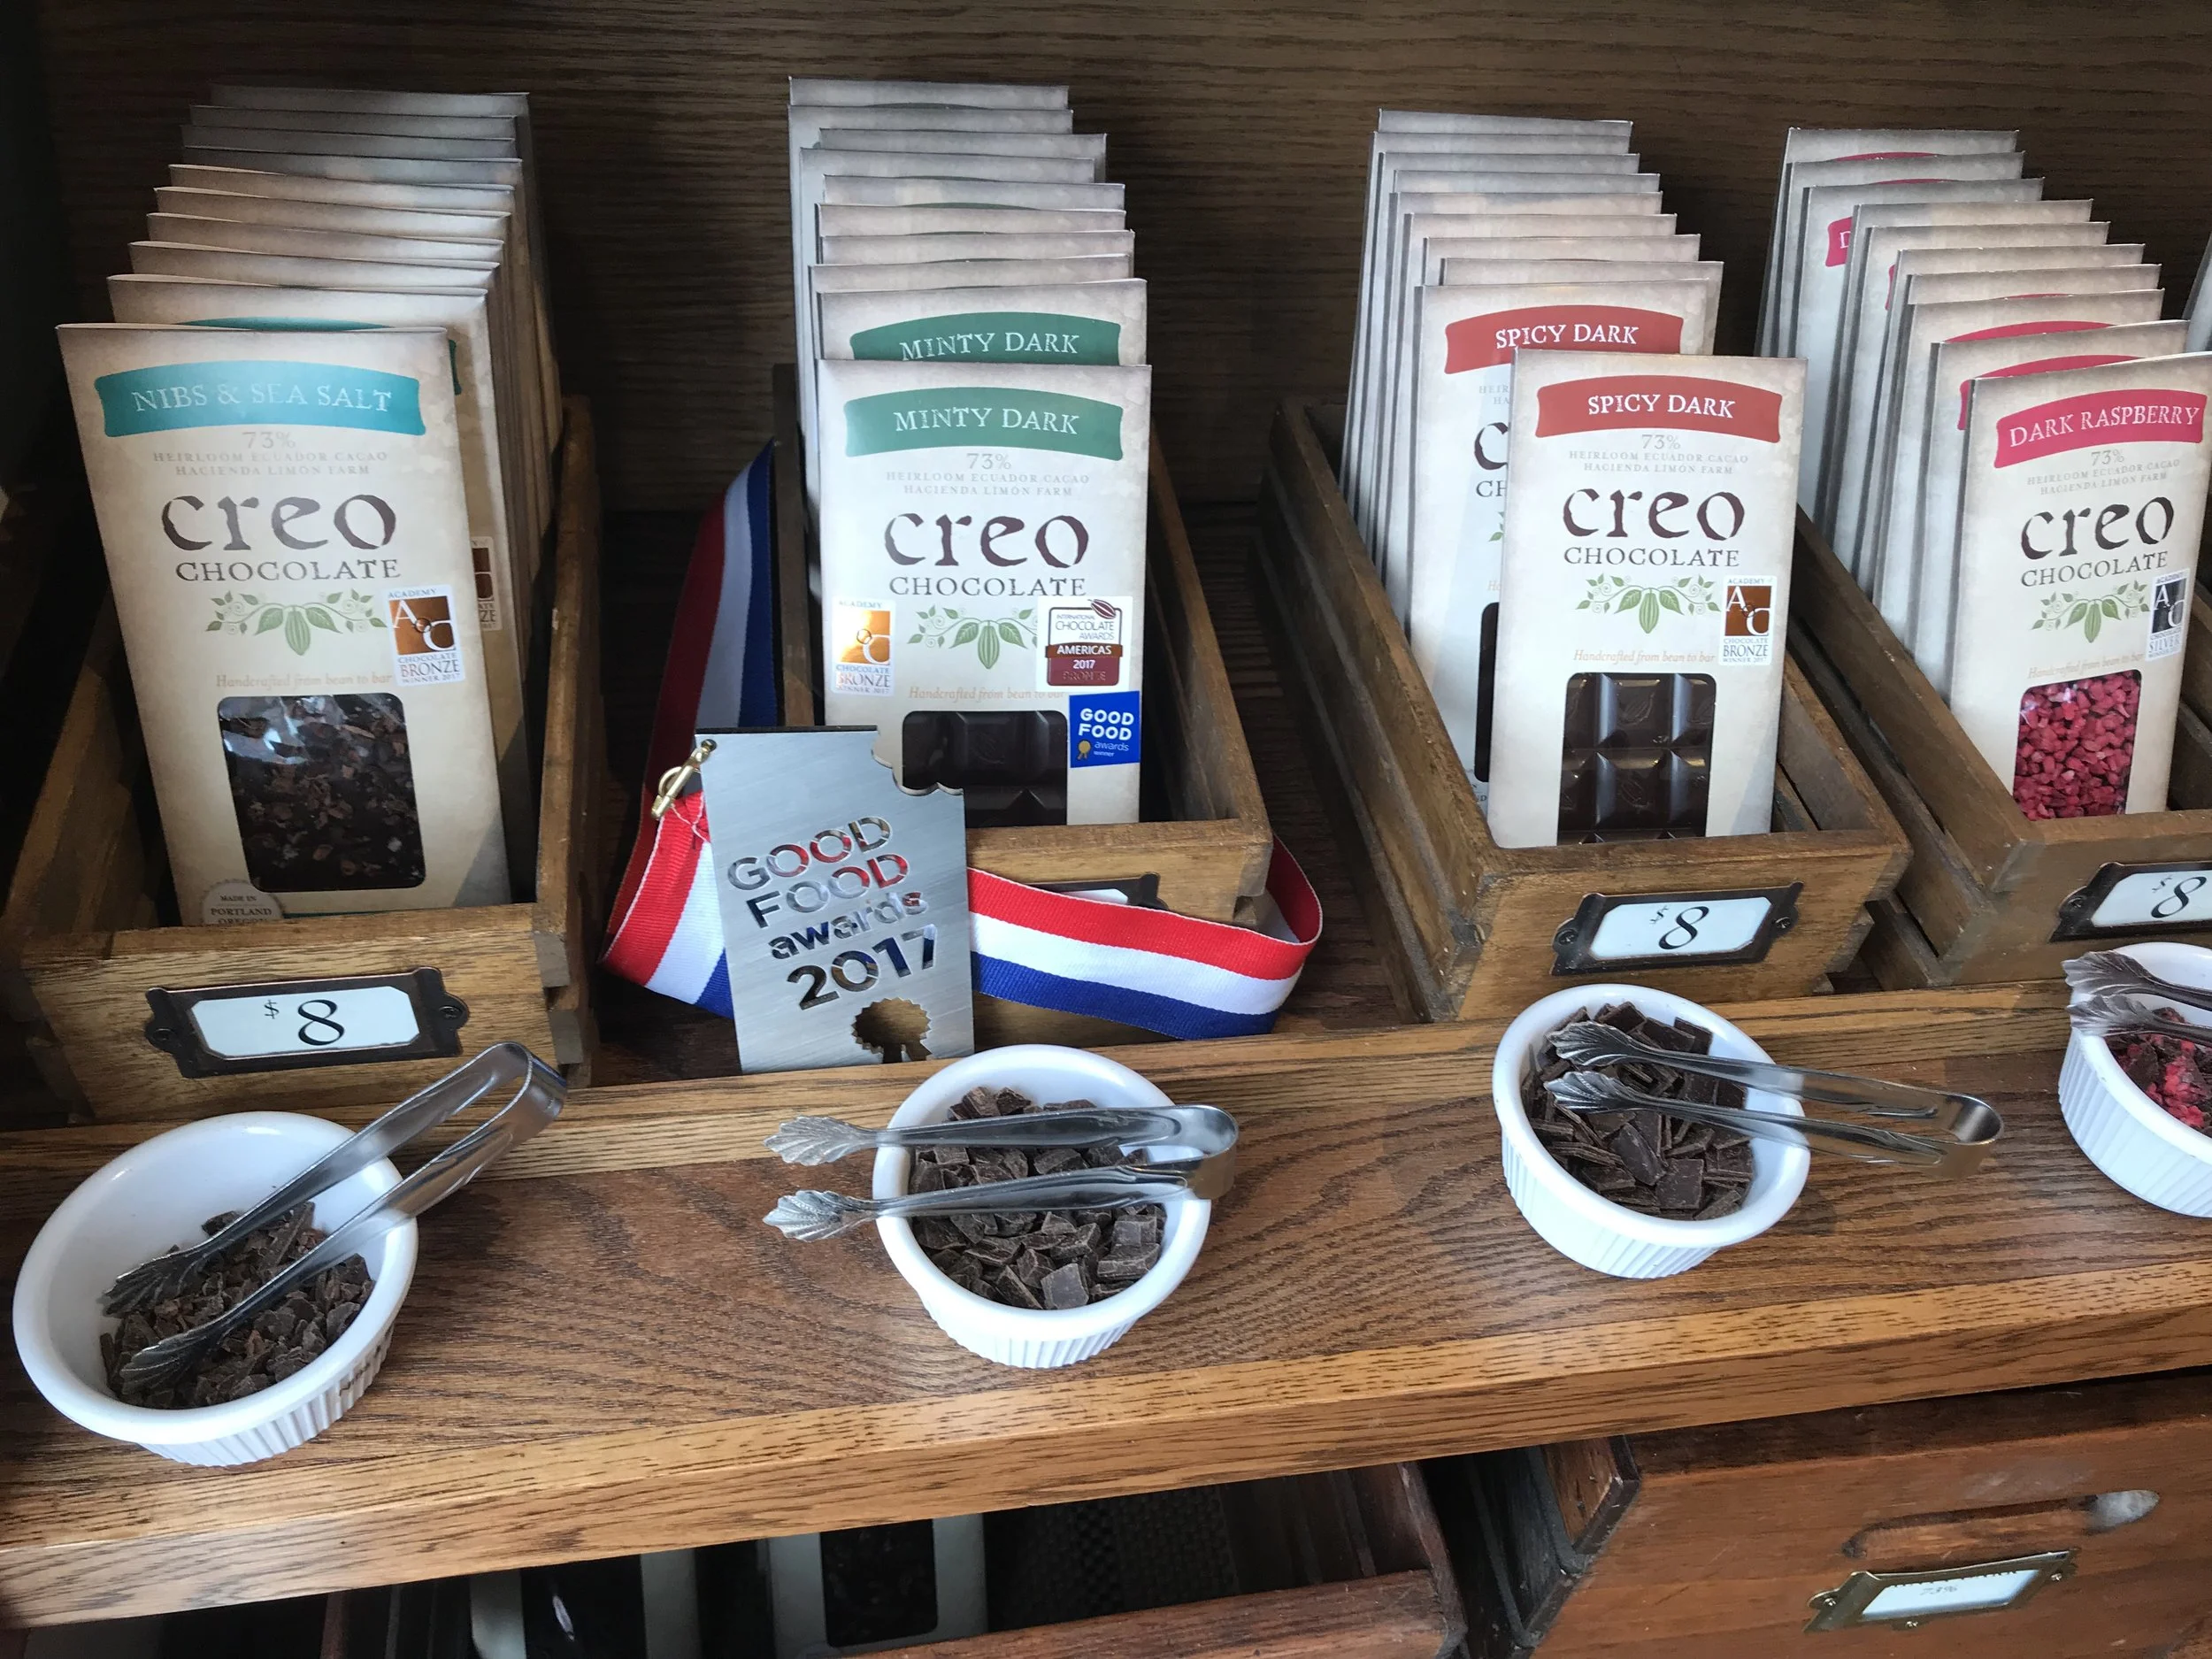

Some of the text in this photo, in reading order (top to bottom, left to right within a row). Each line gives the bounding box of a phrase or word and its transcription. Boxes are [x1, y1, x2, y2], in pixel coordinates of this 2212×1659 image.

[1495, 323, 1640, 349] SPICY DARK
[899, 332, 1080, 361] MINTY DARK
[131, 382, 392, 412] NIBS & SEA SALT
[1479, 385, 1509, 394] HEIR
[1588, 394, 1736, 419] SPICY DARK
[894, 406, 1080, 434] MINTY DARK
[2009, 405, 2200, 448] DARK RASPBERRY
[242, 431, 296, 449] 73%
[1641, 434, 1681, 450] 73%
[153, 451, 388, 463] HEIRLOOM ECUADOR CACAO
[965, 452, 1012, 471] 73%
[1569, 450, 1748, 464] HEIRLOOM ECUADOR CACAO
[2091, 449, 2125, 466] 73%
[175, 465, 260, 477] HACIENDA
[328, 465, 370, 475] FARM
[1584, 463, 1649, 472] HACIENDA
[1701, 465, 1734, 474] FARM
[2027, 458, 2180, 486] HEIRLOOM ECUADOR CACAO
[886, 472, 1090, 484] HEIRLOOM ECUADOR CACAO
[2040, 482, 2098, 495] HACIENDA
[2140, 472, 2168, 483] FARM
[903, 485, 978, 495] HACIENDA
[1036, 487, 1072, 496] FARM
[161, 494, 396, 551] creo
[1563, 488, 1745, 541] creo
[2021, 496, 2174, 560] creo
[884, 512, 1089, 569] creo
[1563, 546, 1740, 567] CHOCOLATE
[175, 557, 401, 582] CHOCOLATE
[2021, 550, 2169, 588] CHOCOLATE
[388, 588, 437, 598] ACADEMY
[889, 576, 1087, 597] CHOCOLATE
[1055, 620, 1115, 632] CHOCOLATE
[1079, 632, 1115, 641] AWARDS
[398, 652, 457, 664] CHOCOLATE
[1056, 645, 1113, 656] AMERICAS
[1574, 649, 1716, 665] Handcrafted from bean to bar
[1723, 644, 1769, 657] BRONZE
[400, 659, 461, 678] BRONZE
[1072, 659, 1096, 670] 2017
[372, 672, 393, 684] bar
[838, 672, 891, 687] BRONZE
[908, 686, 975, 703] Handcrafted
[976, 687, 1003, 703] from
[1007, 687, 1032, 699] bean
[1079, 708, 1135, 726] GOOD
[1078, 723, 1133, 741] FOOD
[1094, 741, 1130, 752] awards
[727, 816, 892, 891] GOOD
[745, 853, 910, 929] FOOD
[768, 890, 928, 960] awards
[787, 923, 938, 1010] 2017
